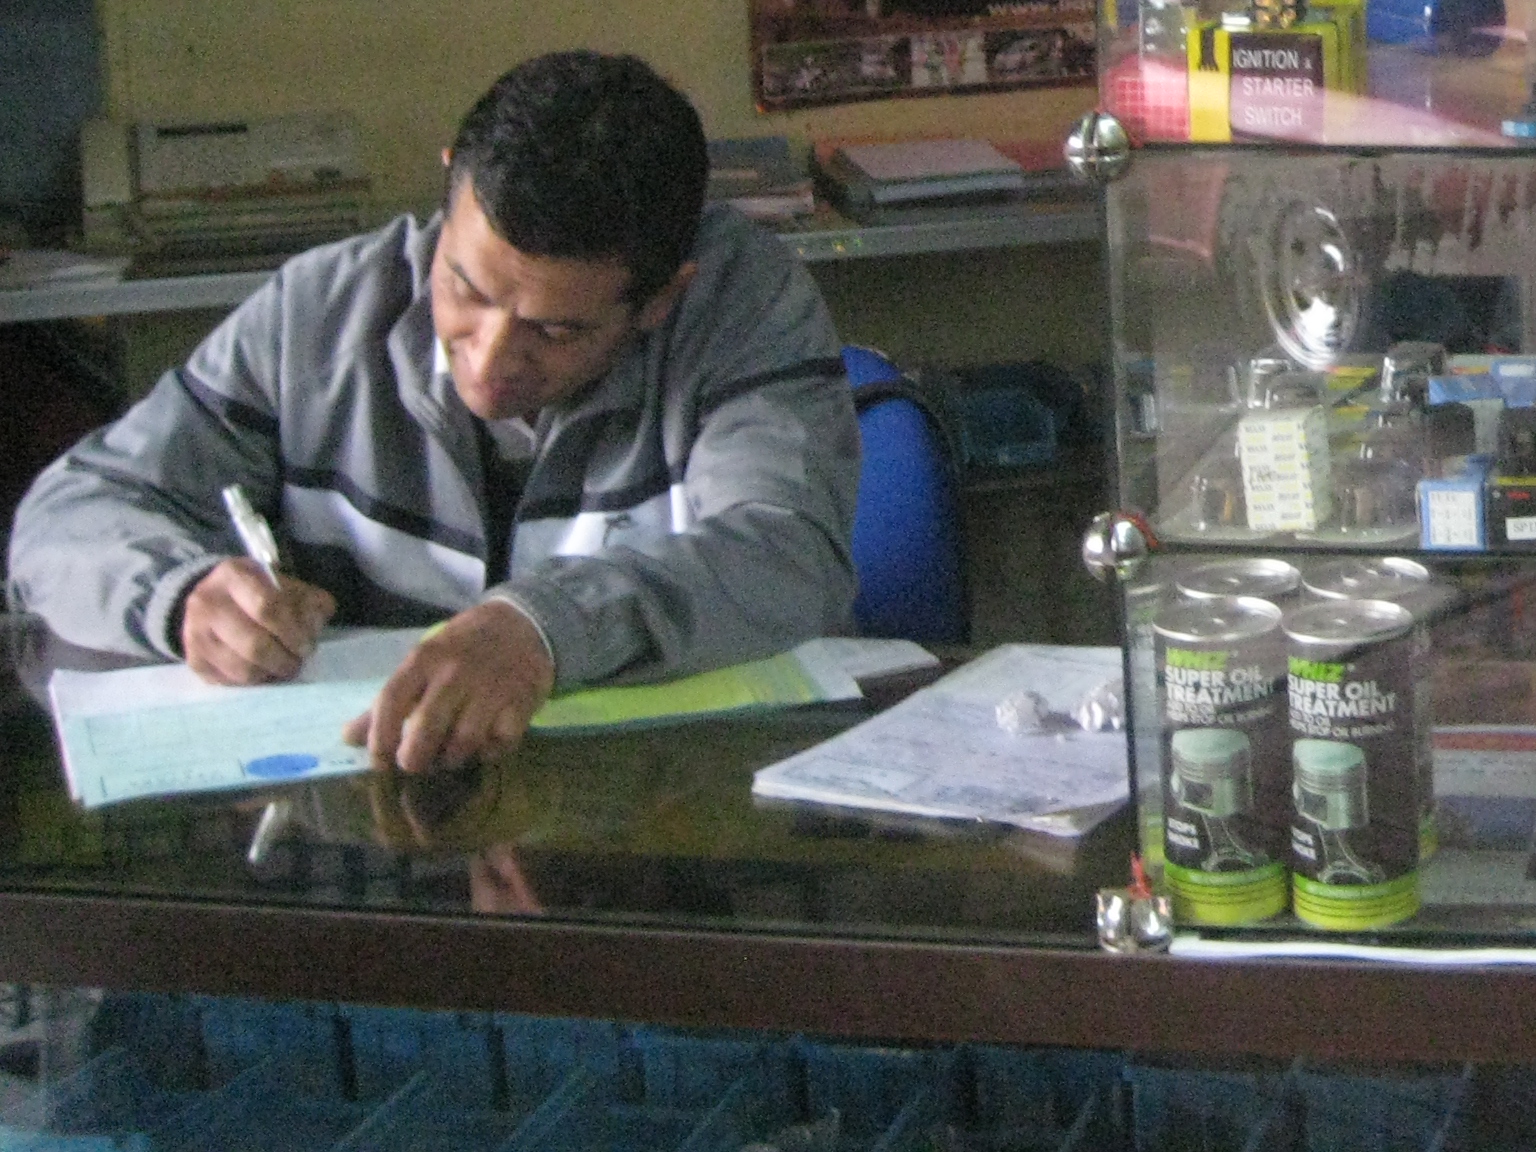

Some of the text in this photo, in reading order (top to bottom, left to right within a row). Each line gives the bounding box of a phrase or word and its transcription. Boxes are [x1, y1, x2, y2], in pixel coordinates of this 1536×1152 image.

[1233, 48, 1299, 70] IGNITION
[1242, 76, 1316, 98] STARTER
[1244, 106, 1303, 127] SWITCH
[1165, 664, 1263, 687] SUPER OIL
[1288, 673, 1379, 700] SUPER OIL
[1288, 692, 1397, 718] TREATMENT
